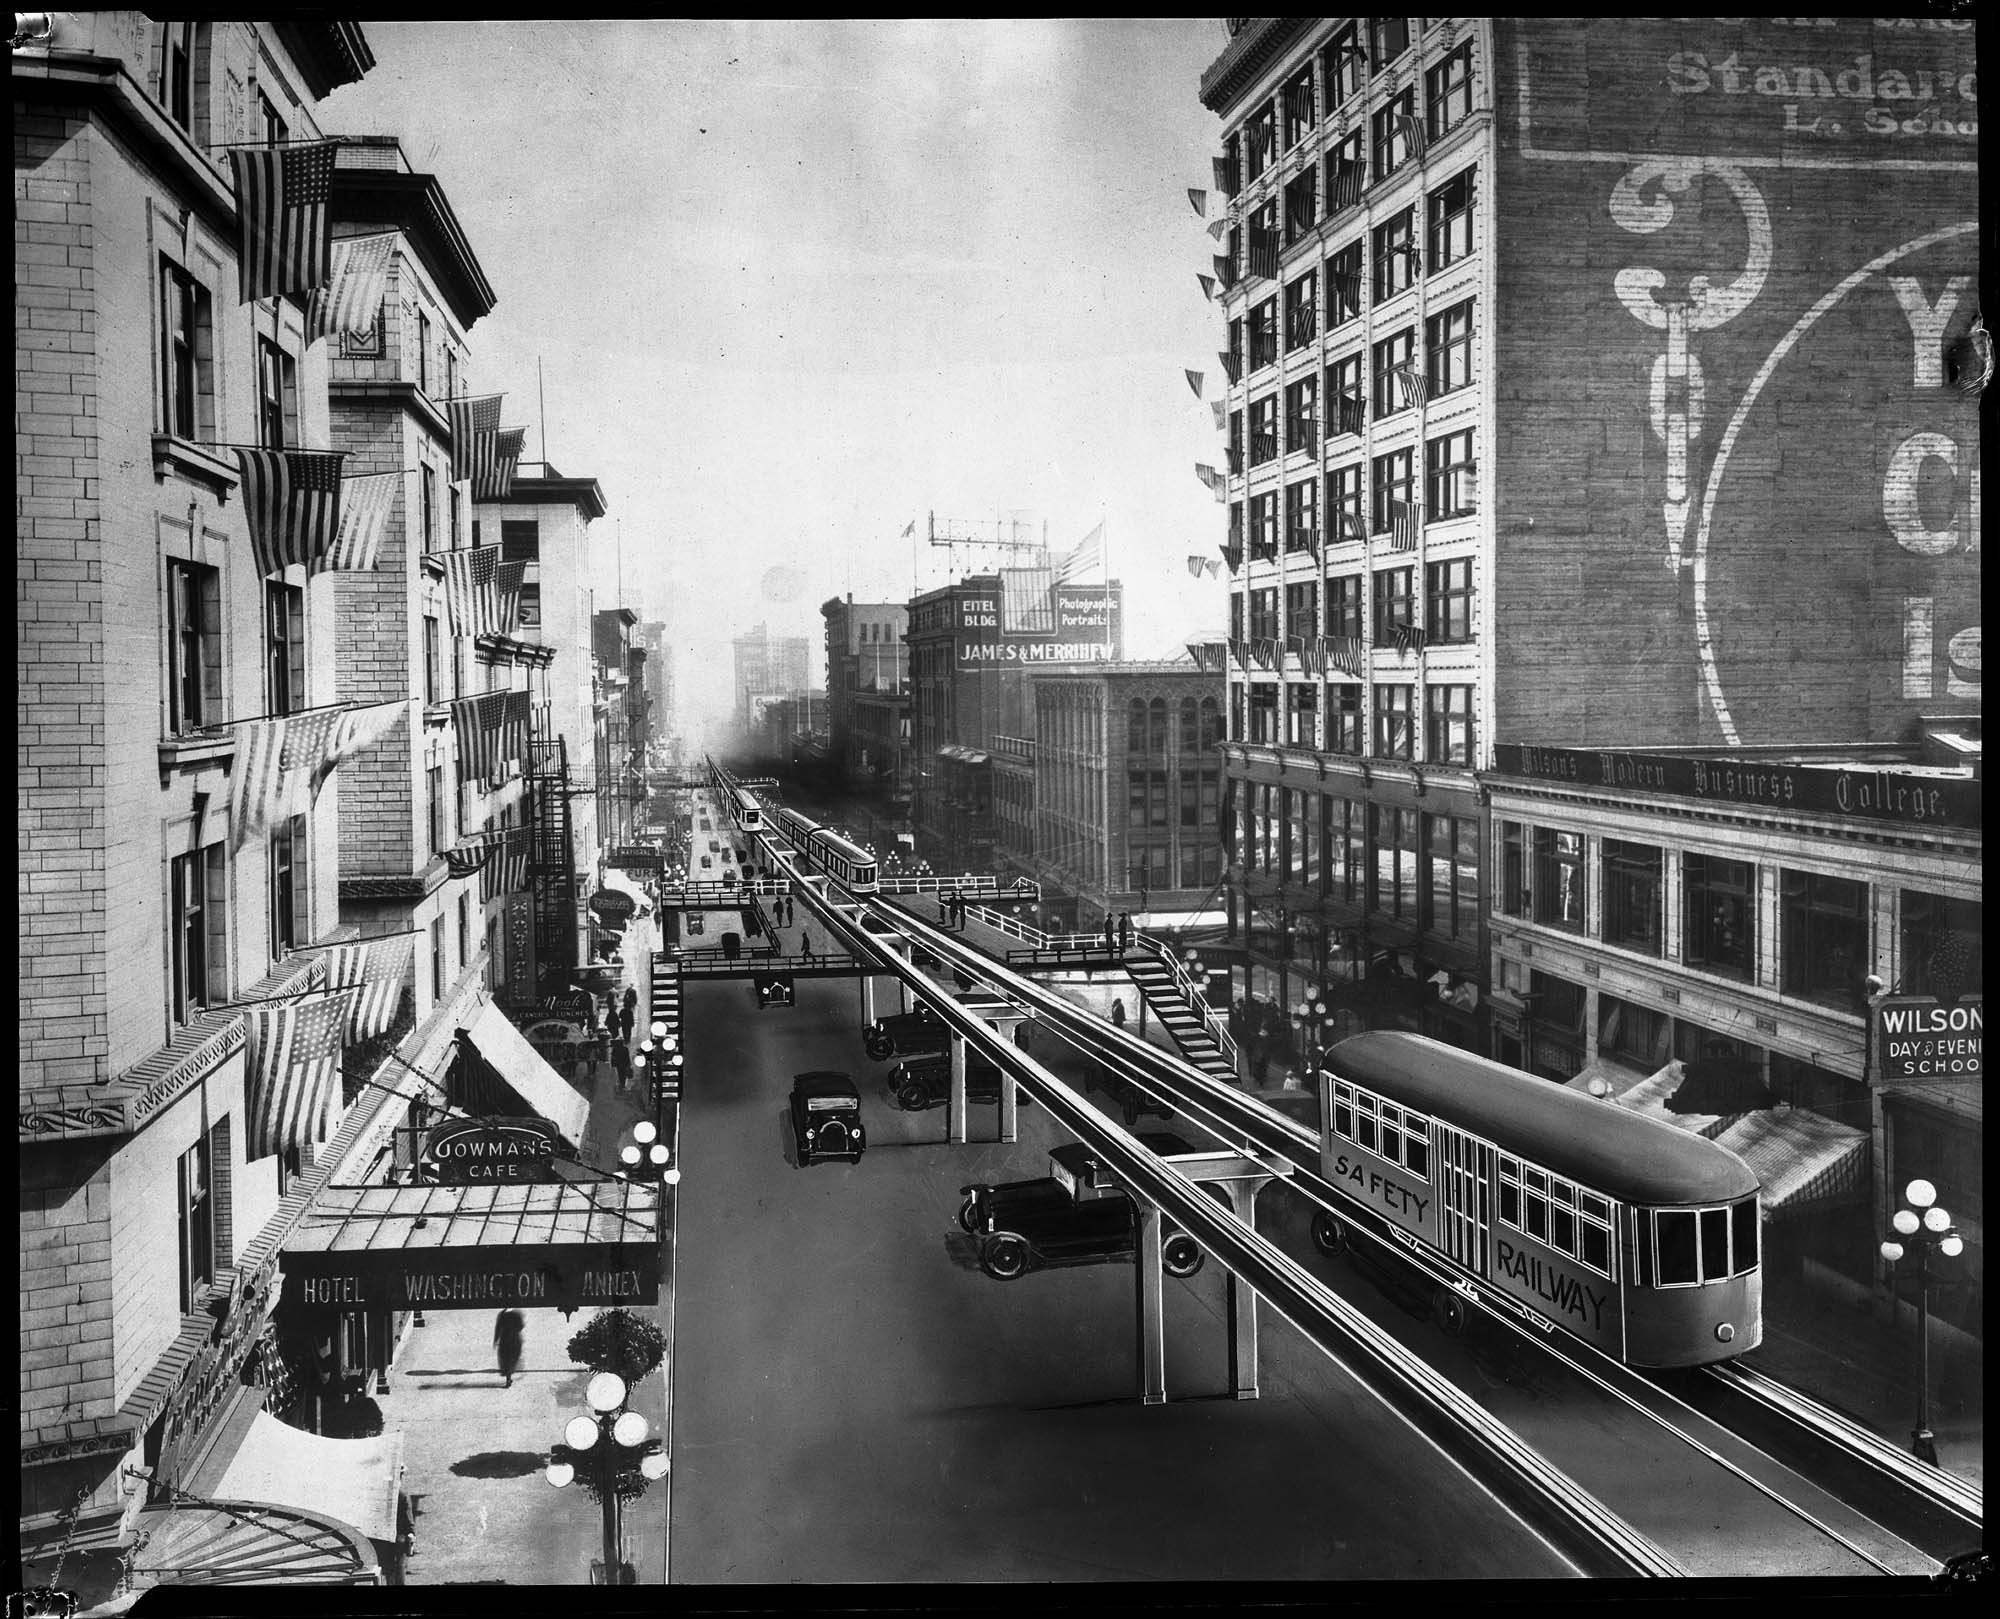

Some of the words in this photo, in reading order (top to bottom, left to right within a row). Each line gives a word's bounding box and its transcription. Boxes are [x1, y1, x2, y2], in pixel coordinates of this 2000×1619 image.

[1883, 432, 1981, 555] C
[963, 600, 997, 612] EITEL
[1062, 614, 1108, 626] Portraits
[961, 644, 1017, 661] JAMES
[627, 868, 660, 879] FURS
[1890, 1041, 1921, 1057] DAY
[1904, 1058, 1980, 1074] SCHOO
[469, 1165, 518, 1177] CAFE
[1334, 1155, 1429, 1224] SAFETY
[303, 1277, 366, 1304] HOTEL
[581, 1271, 642, 1297] ANNEX
[1497, 1239, 1606, 1331] RAILWAY
